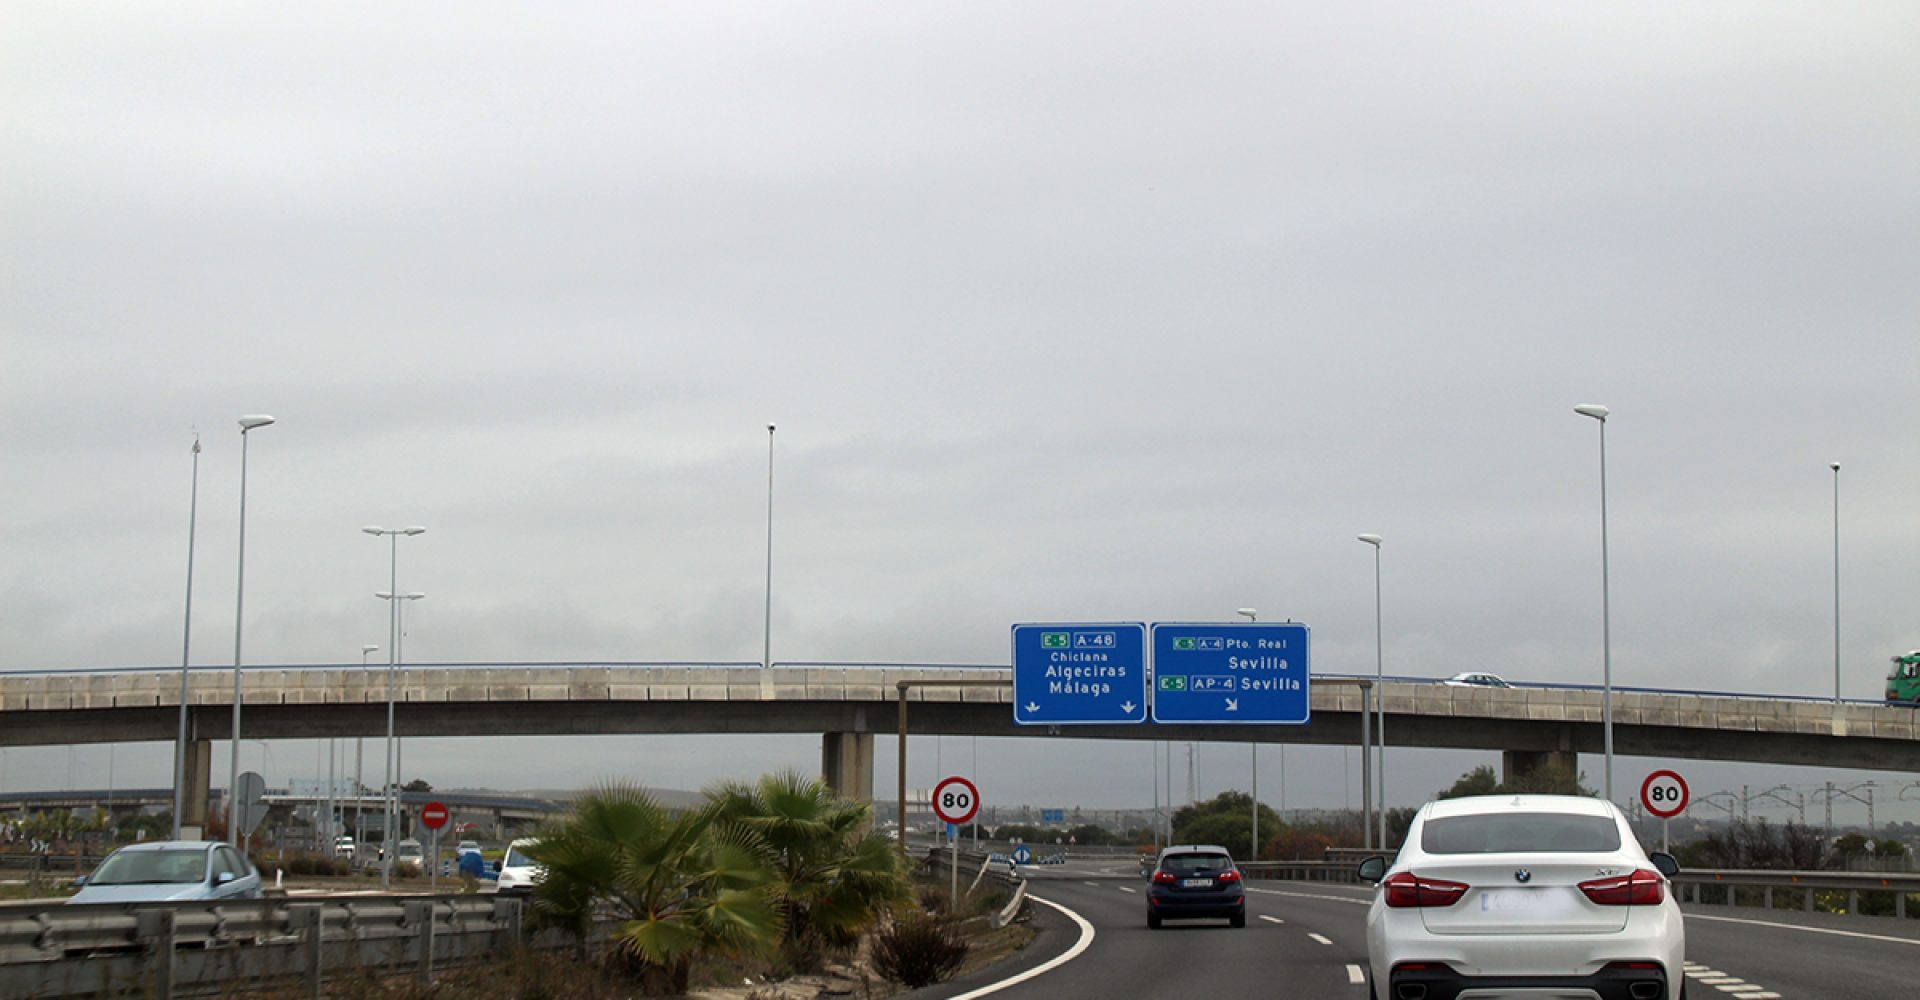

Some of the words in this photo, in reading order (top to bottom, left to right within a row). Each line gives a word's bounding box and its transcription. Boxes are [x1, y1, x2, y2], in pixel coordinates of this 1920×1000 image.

[1226, 639, 1252, 649] Pto.
[1258, 639, 1287, 649] Real
[1050, 652, 1108, 662] Chiclana
[1228, 656, 1288, 670] Sevilla
[1044, 665, 1126, 680] Algeciras
[1049, 680, 1110, 697] Málaga
[1241, 677, 1300, 690] Sevilla
[943, 792, 969, 808] 80
[1652, 786, 1679, 801] 80
